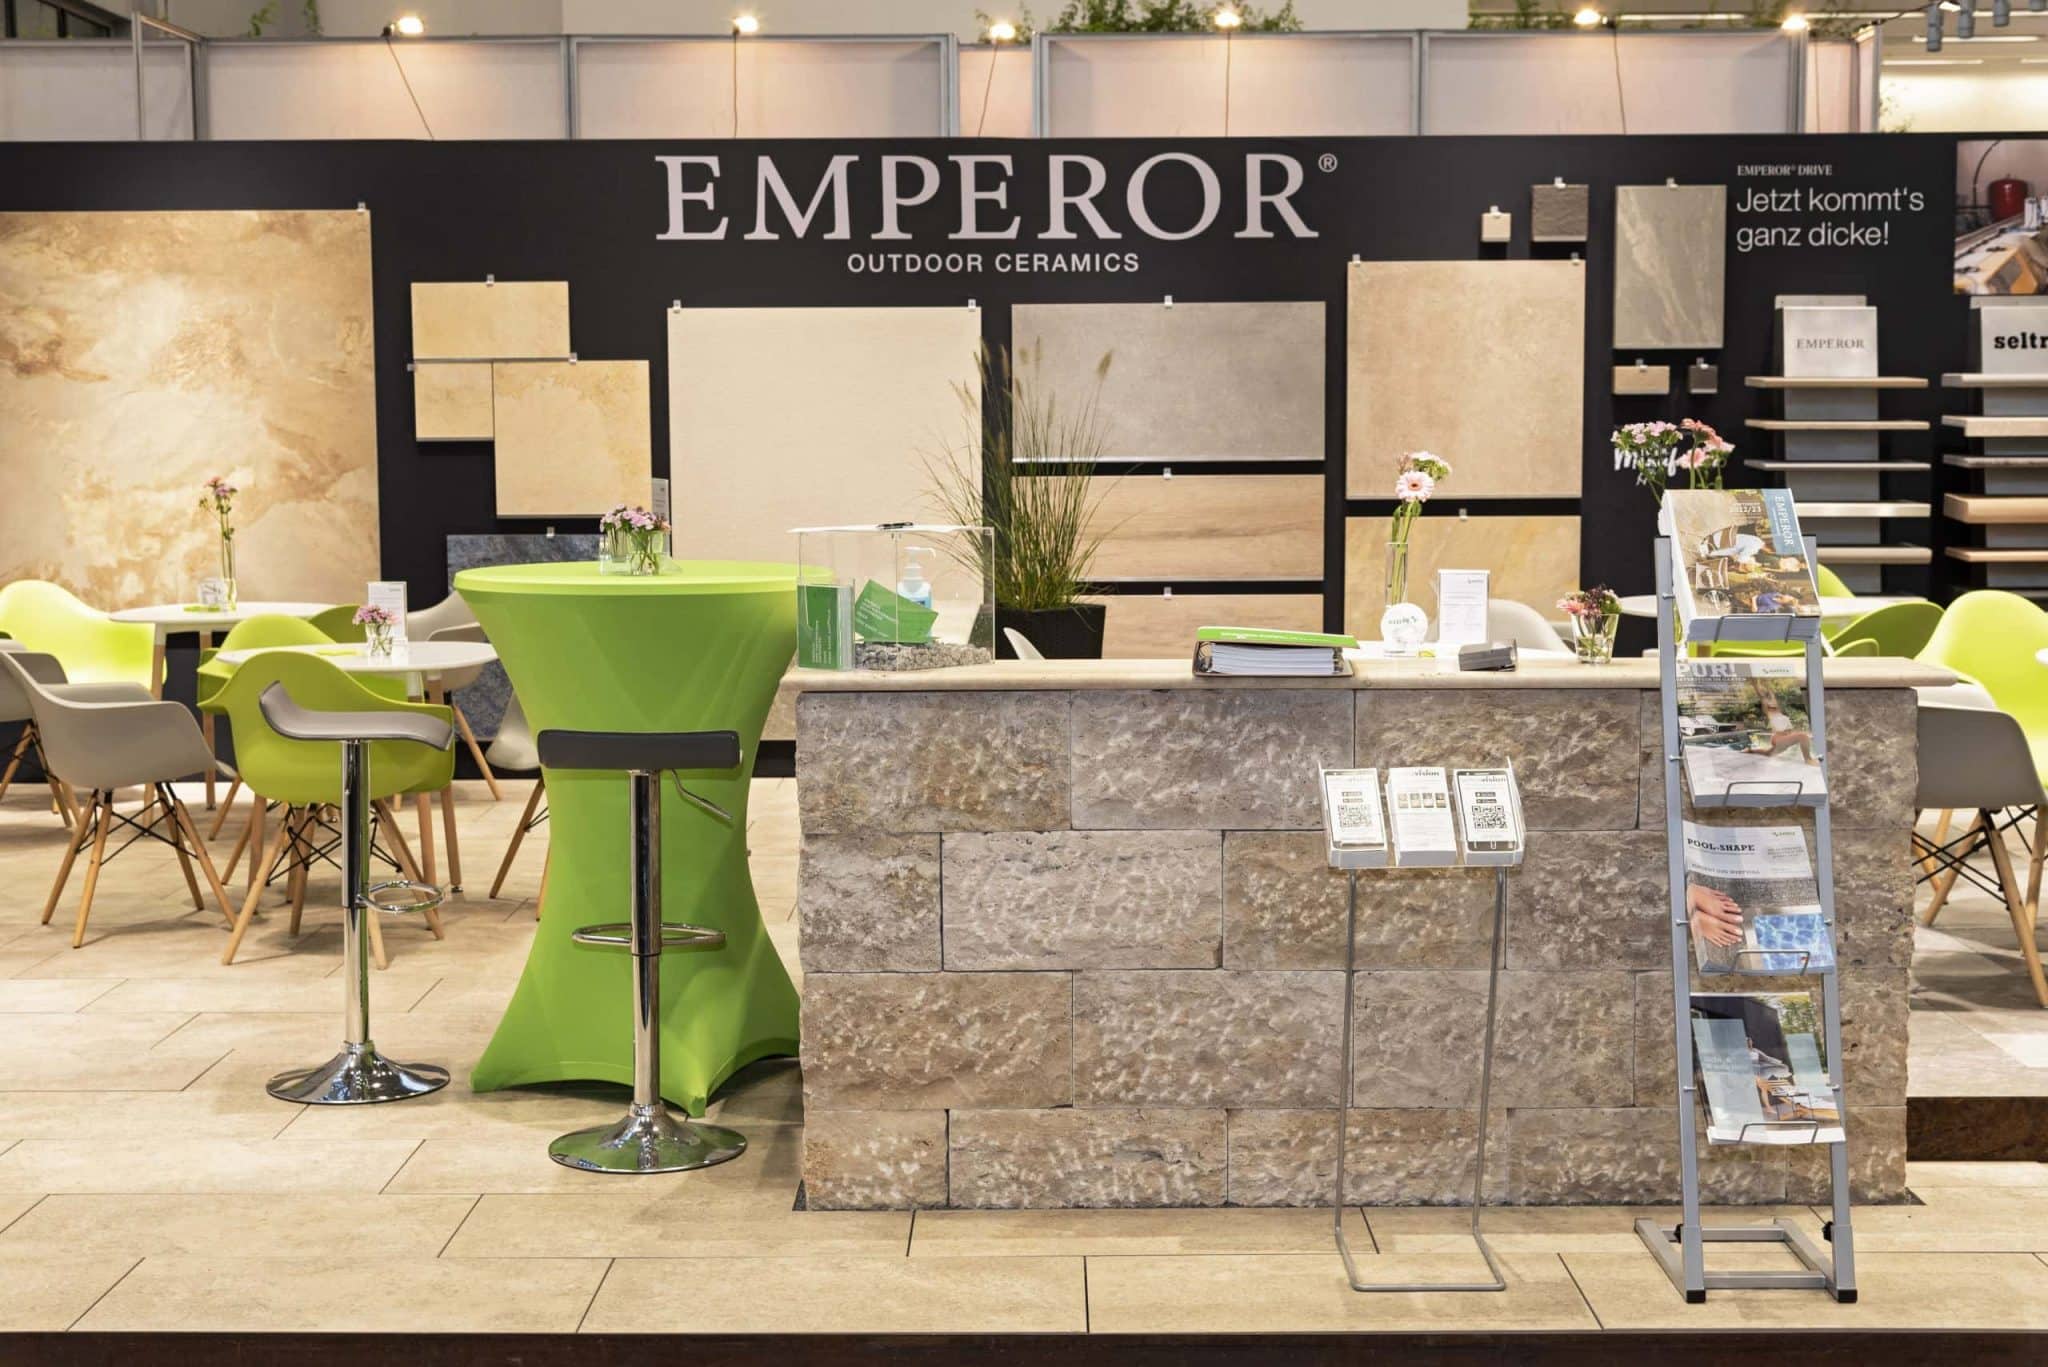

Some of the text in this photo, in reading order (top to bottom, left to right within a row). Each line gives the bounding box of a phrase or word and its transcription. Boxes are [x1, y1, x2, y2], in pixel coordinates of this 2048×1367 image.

[1798, 164, 1833, 176] DRIVE
[1736, 187, 1801, 212] Jetzt
[1736, 221, 1889, 253] ganz dicke!
[848, 253, 1139, 273] OUTDOOR CERAMICS
[1796, 338, 1865, 350] EMPEROR
[1687, 838, 1756, 851] POOL-SHAPE
